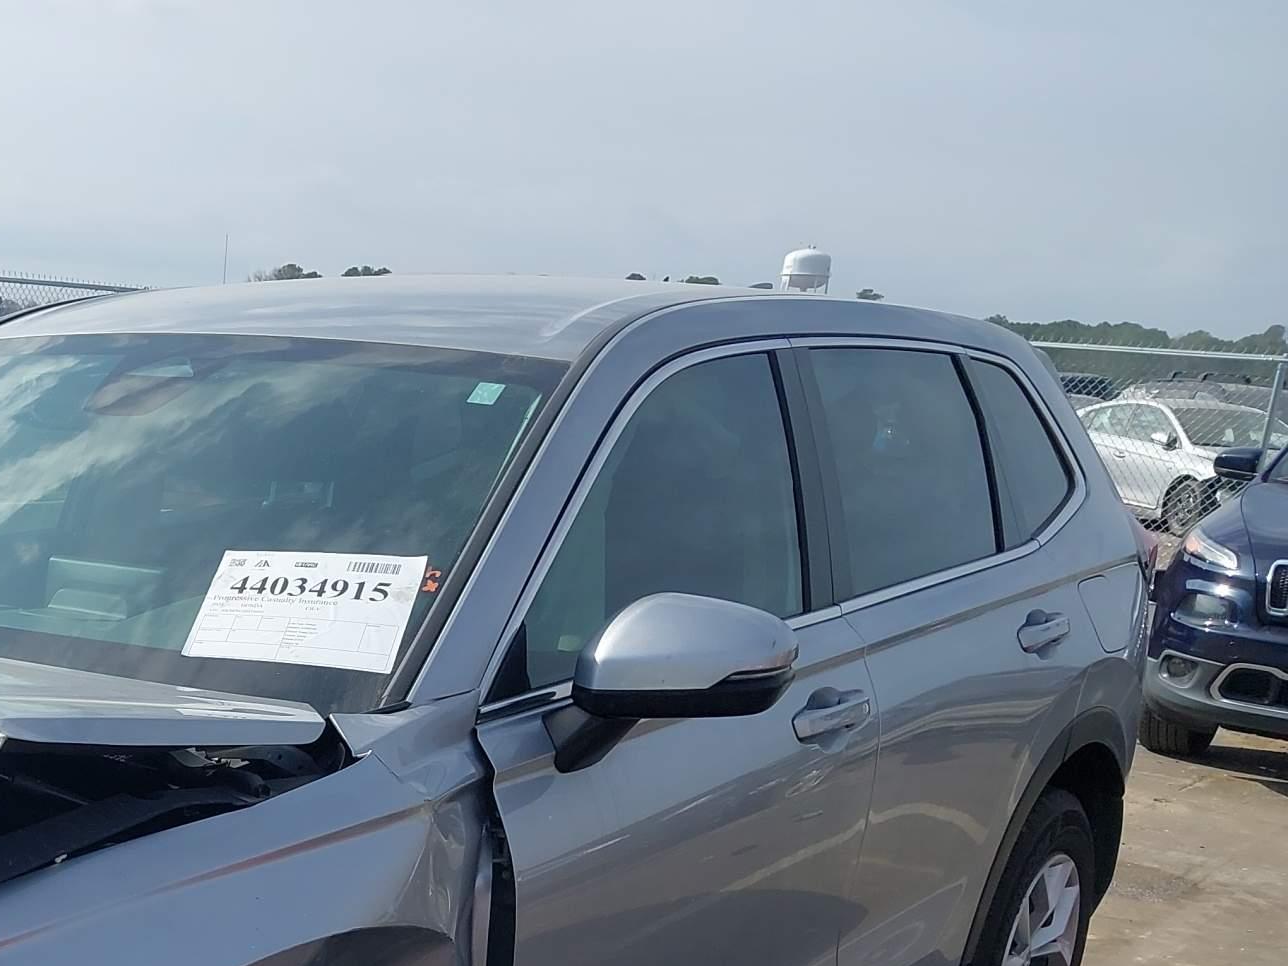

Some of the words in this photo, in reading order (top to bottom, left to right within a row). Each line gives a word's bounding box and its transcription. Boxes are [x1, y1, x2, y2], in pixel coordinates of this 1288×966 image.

[229, 575, 393, 602] 44034915
[213, 594, 259, 603] Progressive
[261, 595, 296, 604] Casualty
[298, 598, 339, 606] Insurance
